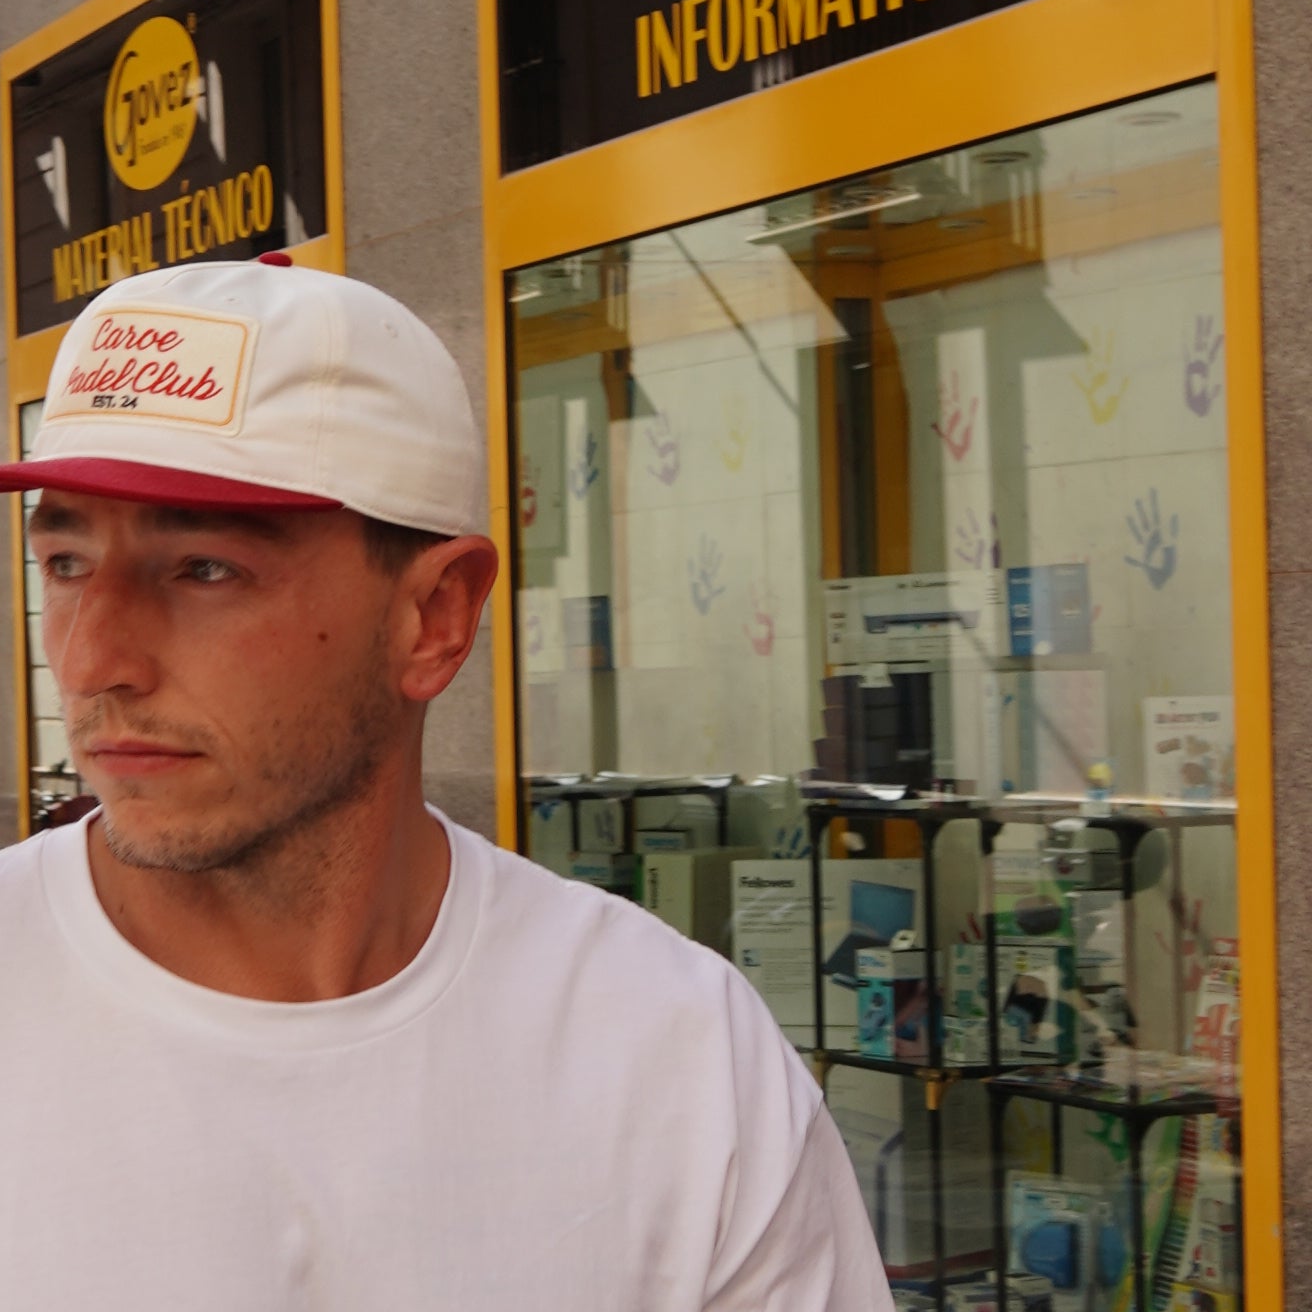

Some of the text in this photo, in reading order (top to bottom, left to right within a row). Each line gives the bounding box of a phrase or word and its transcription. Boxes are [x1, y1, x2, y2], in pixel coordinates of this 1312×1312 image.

[111, 49, 192, 168] Govez
[53, 164, 274, 303] MATERIAL TÉCNICO
[91, 317, 184, 353] Caroe
[131, 360, 224, 401] Club
[120, 394, 139, 410] 24
